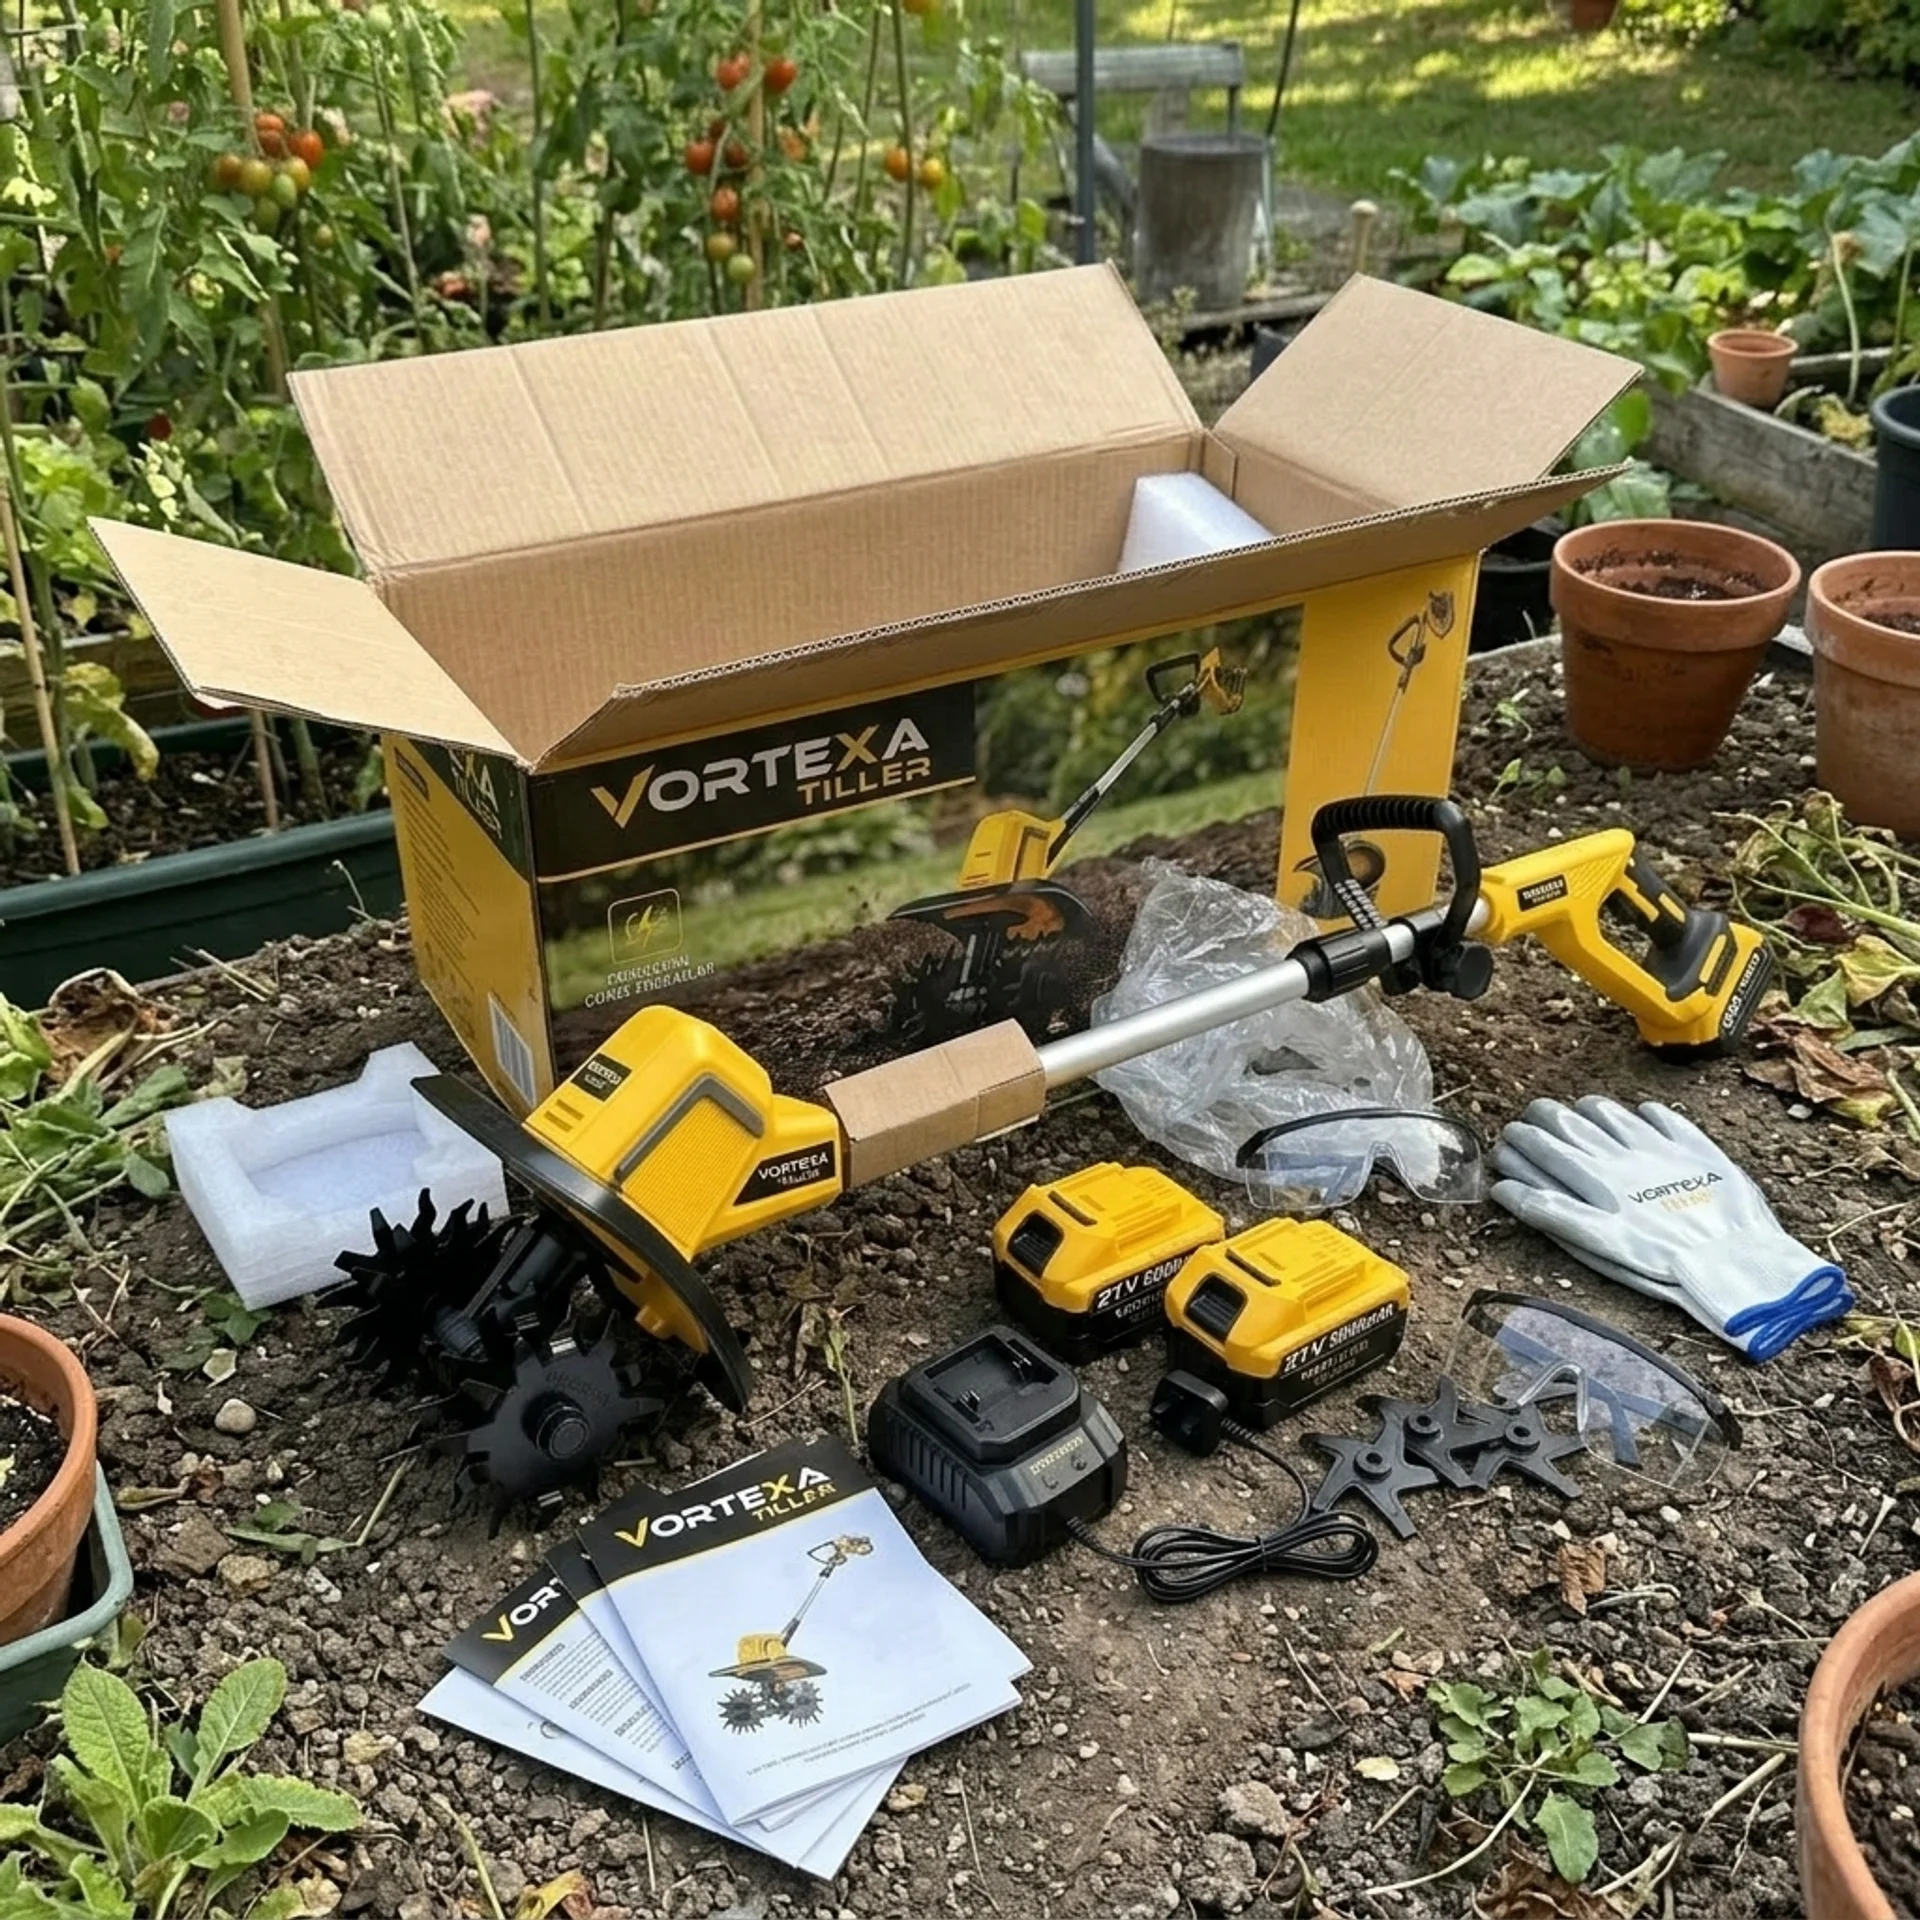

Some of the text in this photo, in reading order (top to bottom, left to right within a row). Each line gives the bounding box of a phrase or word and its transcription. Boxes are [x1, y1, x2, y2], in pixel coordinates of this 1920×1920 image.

[590, 718, 931, 829] VORTEXA
[797, 756, 932, 805] TILLER
[614, 1466, 831, 1548] VORTEXA
